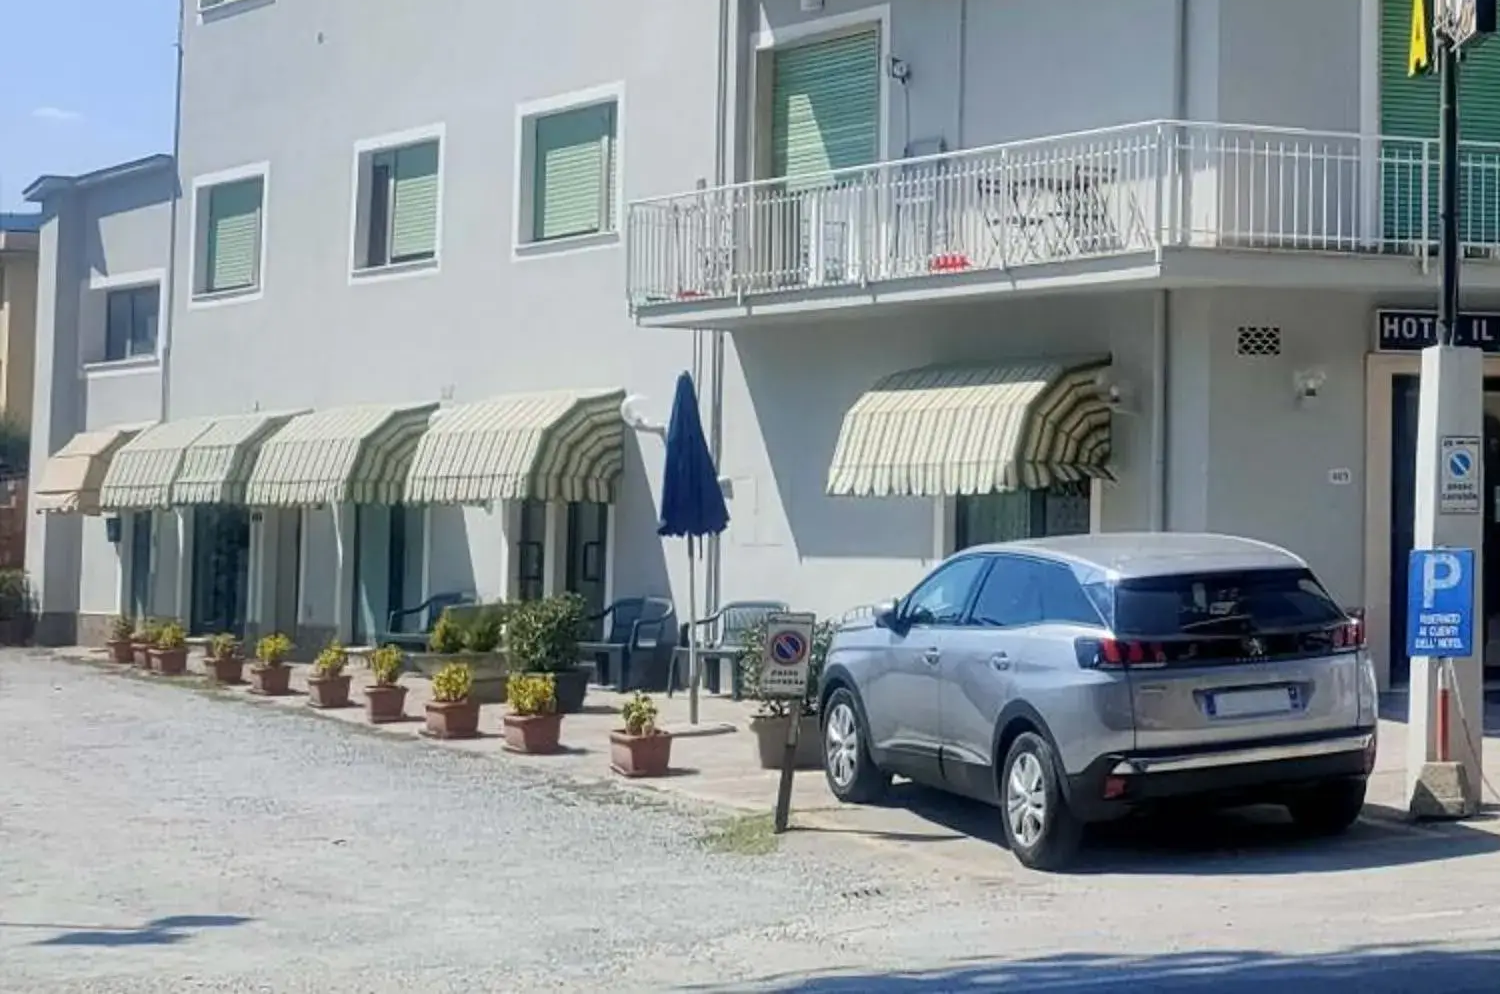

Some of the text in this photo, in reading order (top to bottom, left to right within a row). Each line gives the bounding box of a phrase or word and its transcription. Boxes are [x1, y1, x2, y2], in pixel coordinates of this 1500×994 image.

[1383, 316, 1463, 340] HOT
[1472, 318, 1494, 341] IL
[1423, 552, 1462, 609] P
